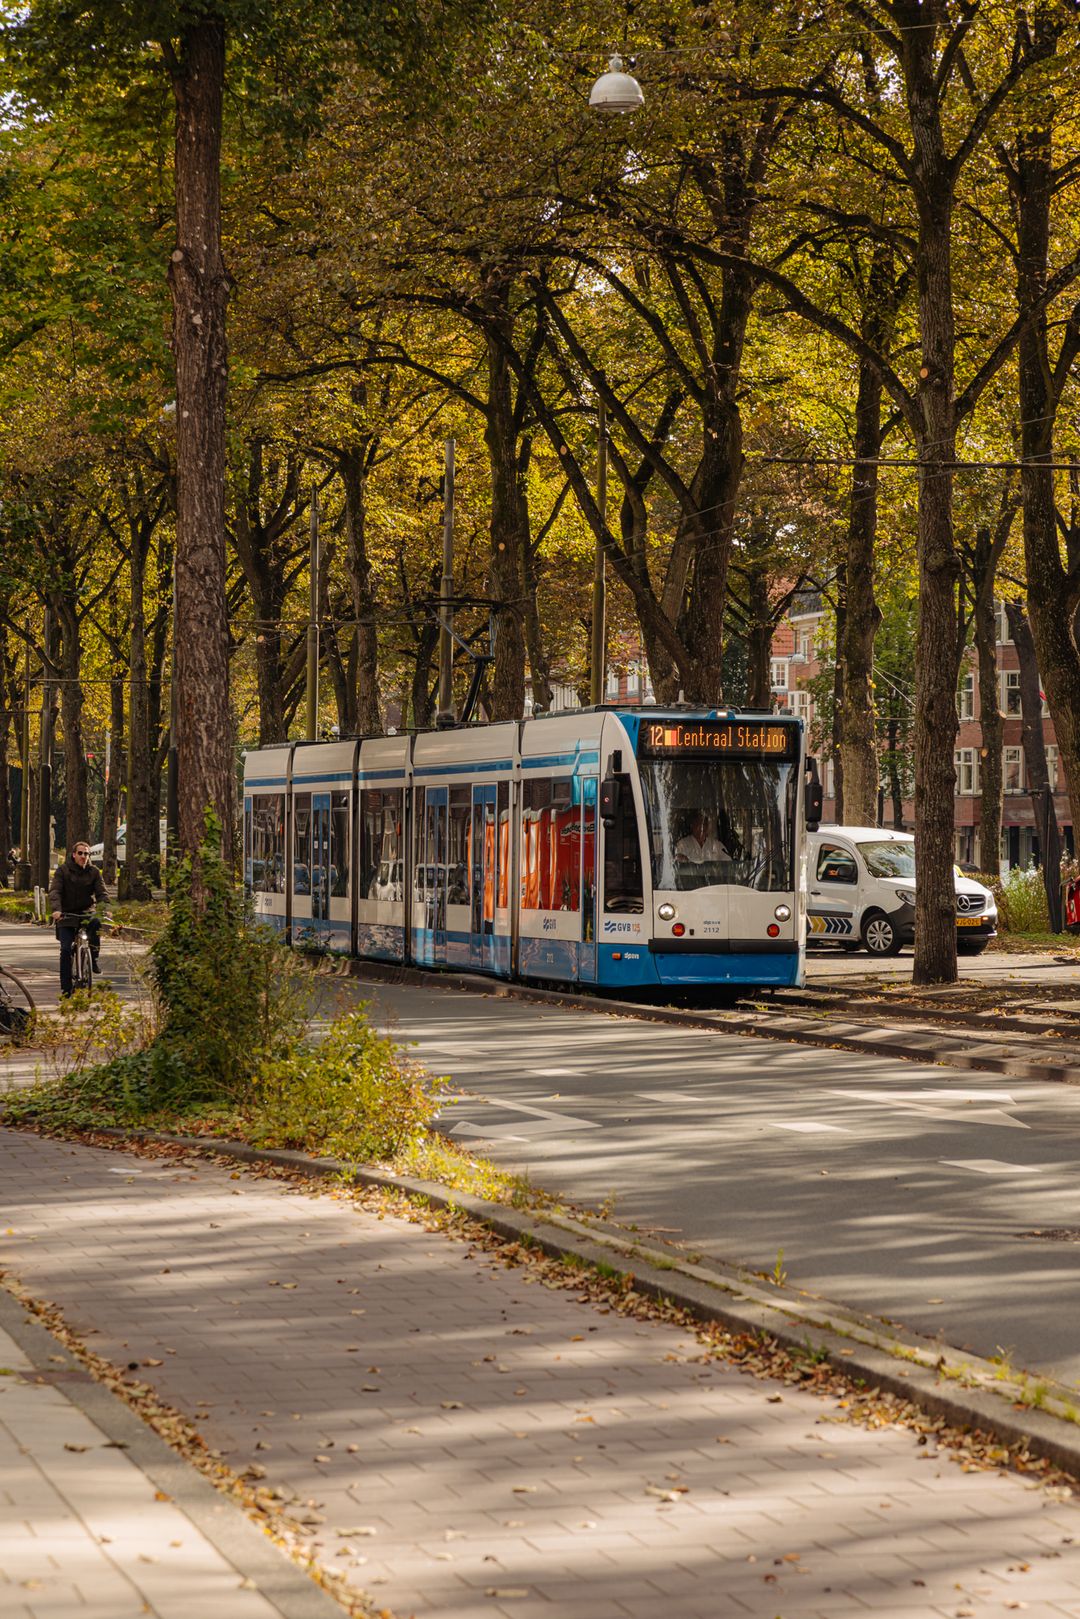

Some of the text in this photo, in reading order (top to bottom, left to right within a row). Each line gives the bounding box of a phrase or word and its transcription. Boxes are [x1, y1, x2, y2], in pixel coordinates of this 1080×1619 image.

[650, 725, 786, 748] 12 Centraal Station
[617, 923, 631, 932] GVB
